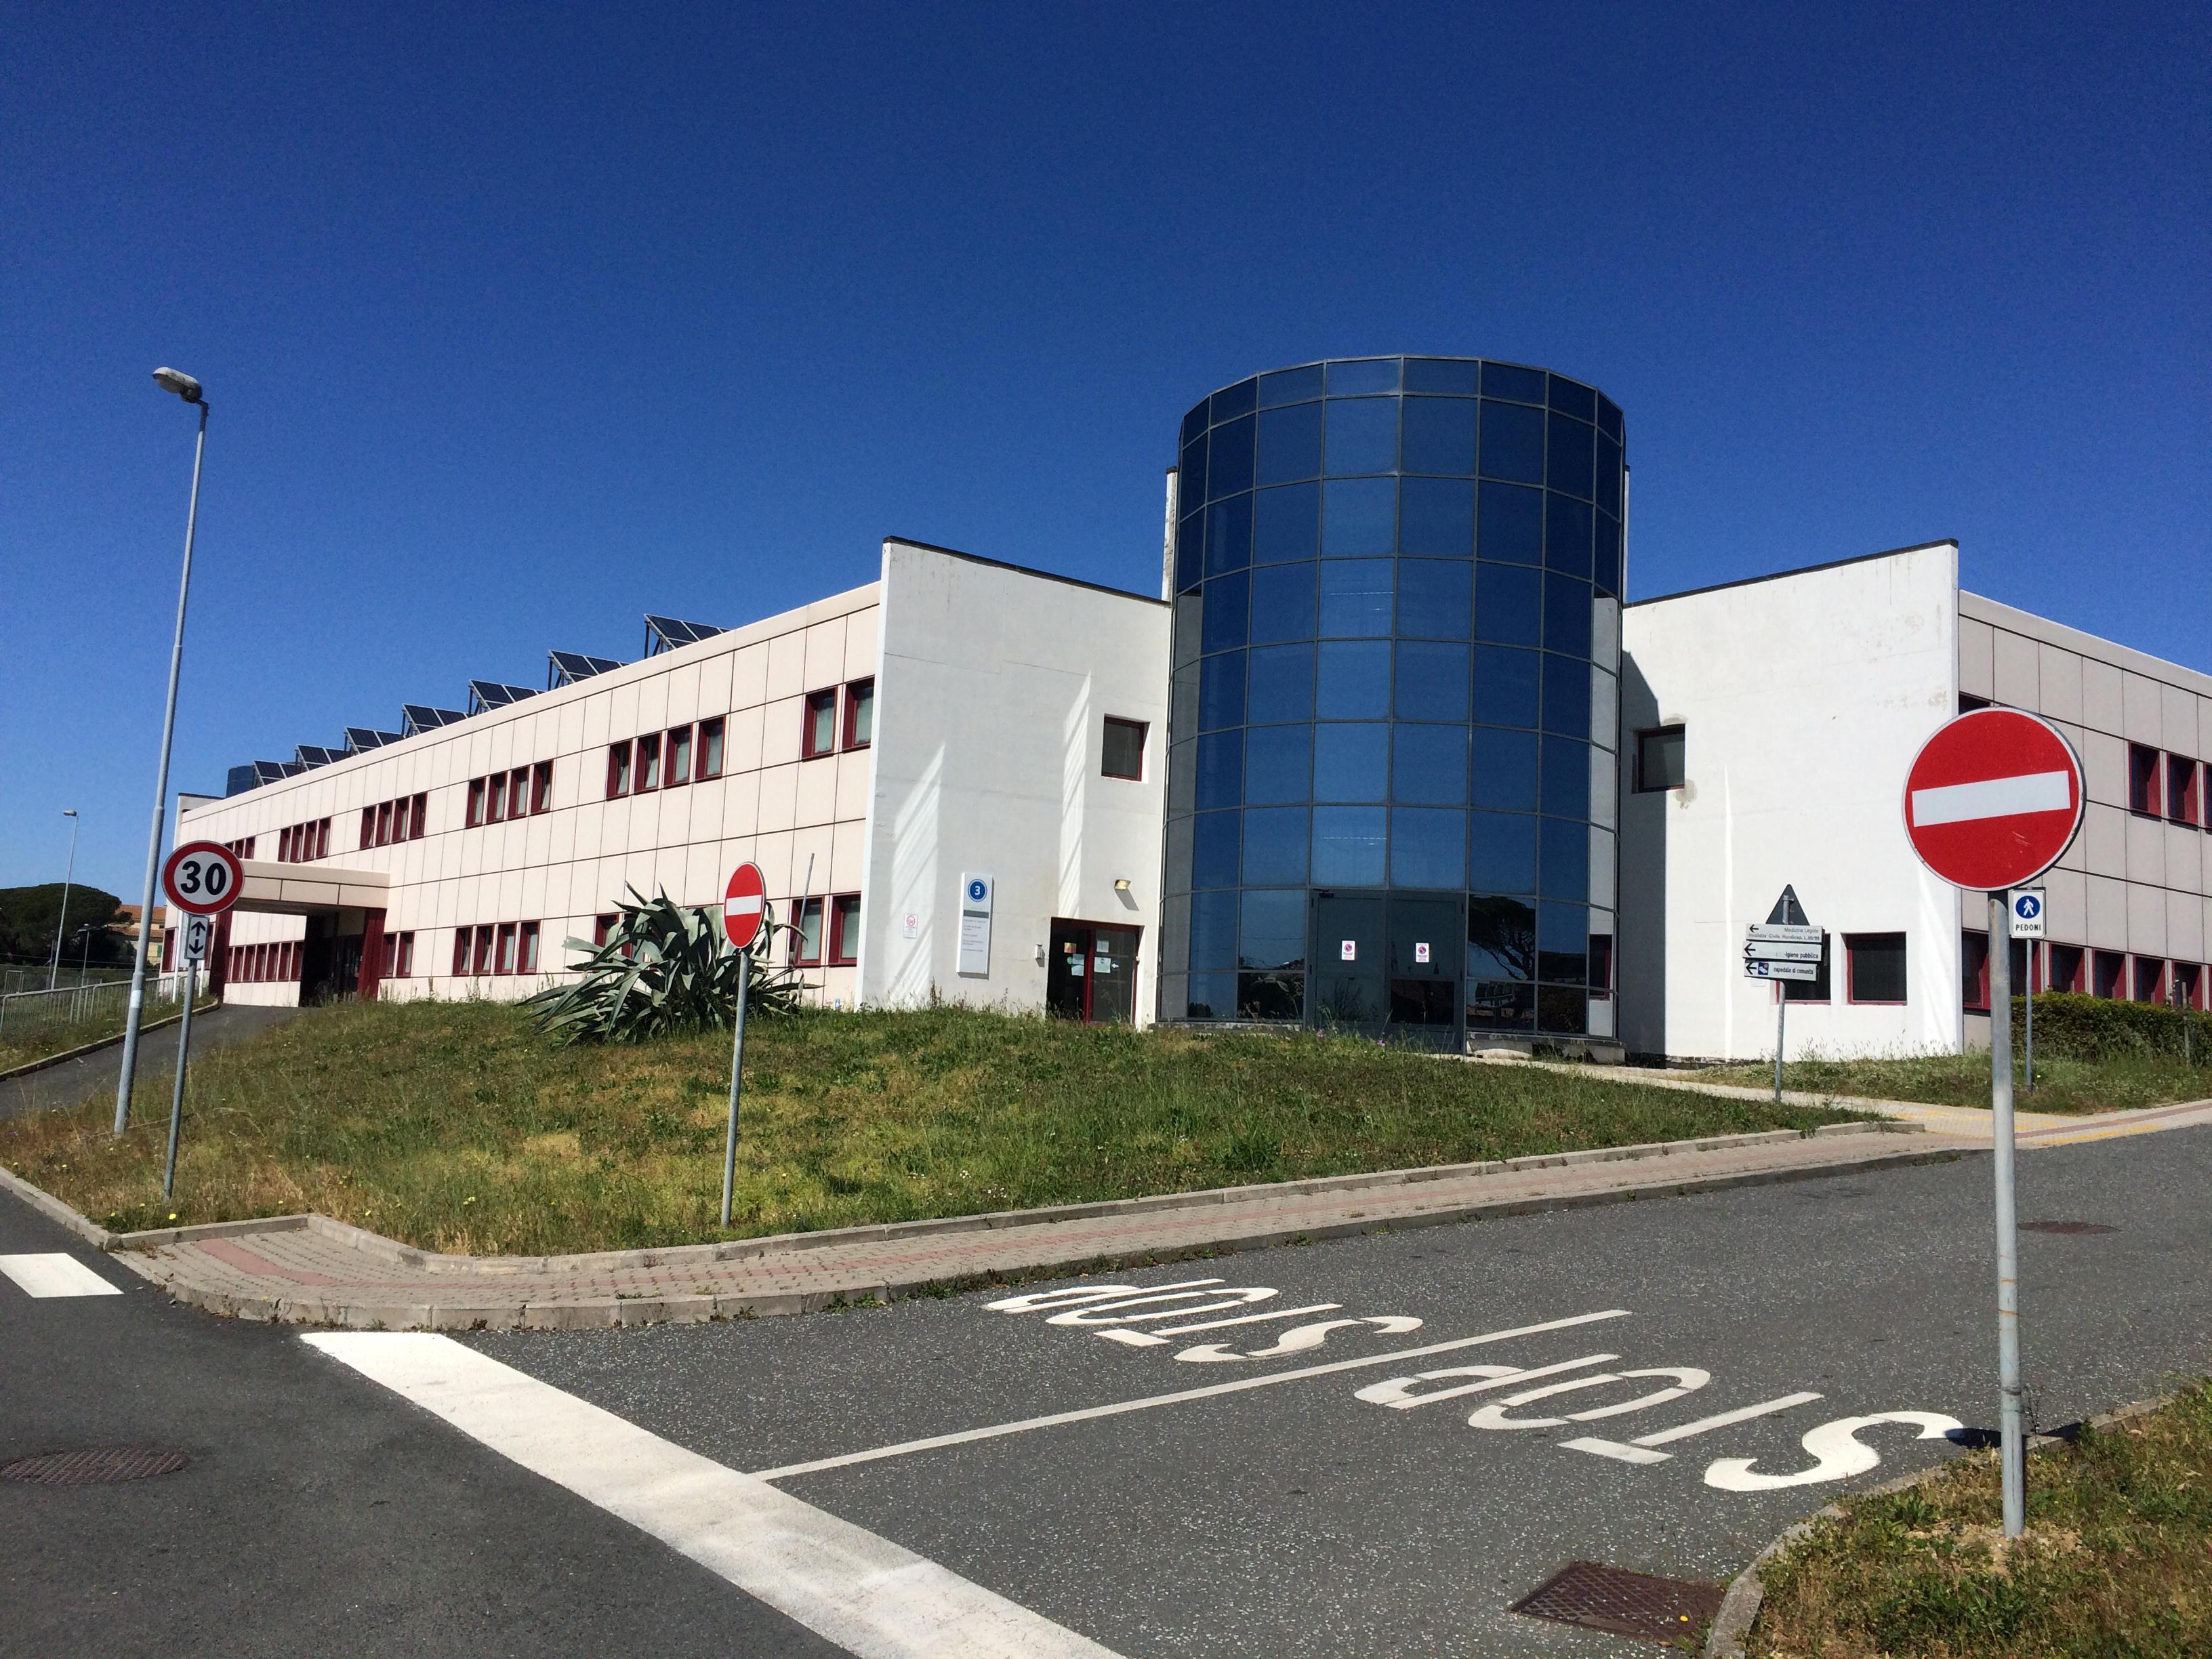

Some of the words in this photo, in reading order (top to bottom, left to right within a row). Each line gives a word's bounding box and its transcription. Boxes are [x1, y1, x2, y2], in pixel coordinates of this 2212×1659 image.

[180, 861, 226, 895] 30
[975, 886, 981, 895] 3
[981, 1278, 1423, 1362] STOP
[1354, 1353, 1964, 1491] STOP
